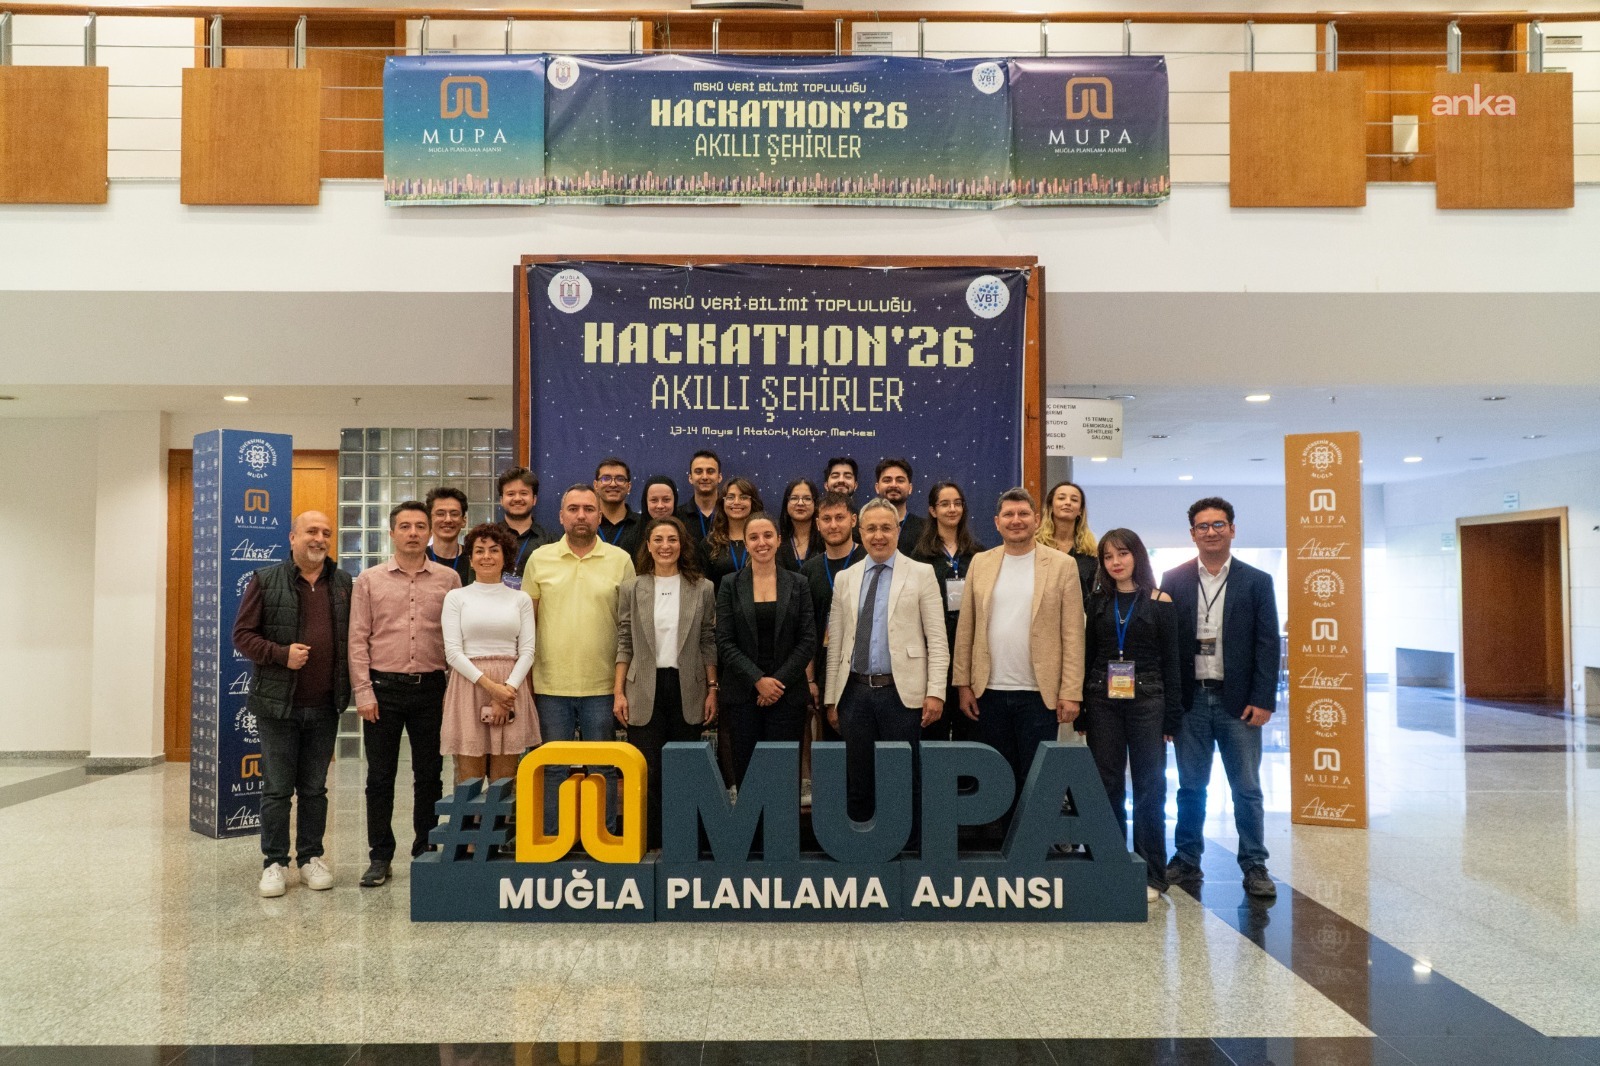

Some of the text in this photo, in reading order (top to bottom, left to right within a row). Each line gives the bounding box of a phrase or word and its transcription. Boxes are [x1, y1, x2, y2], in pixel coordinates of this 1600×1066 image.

[693, 81, 867, 93] MSKÜ VERİ BİLİMİ TOPLULUĞU
[651, 99, 908, 129] HACKATHON'26
[422, 128, 508, 144] MUPA
[1048, 129, 1133, 145] MUPA
[695, 129, 861, 166] AKILLI ŞEHİRLER
[649, 295, 912, 312] MSKÜ VERİ BİLİMİ TOPLULUĞU
[977, 294, 999, 302] VBT
[584, 322, 975, 367] HACKATHON'26
[652, 367, 904, 423] AKILLI ŞEHİRLER
[670, 426, 698, 435] 13-14
[702, 427, 734, 437] Mayıs
[830, 428, 876, 437] Merkezi
[234, 515, 279, 526] MUPA
[1300, 515, 1347, 524] MUPA
[1302, 644, 1349, 654] MUPA
[231, 780, 265, 792] MUP
[1304, 774, 1351, 785] MUPA
[662, 741, 1134, 863] MUPA
[242, 818, 260, 826] ARA
[499, 868, 1064, 910] MUĞLA PLANLAMA AJANSI
